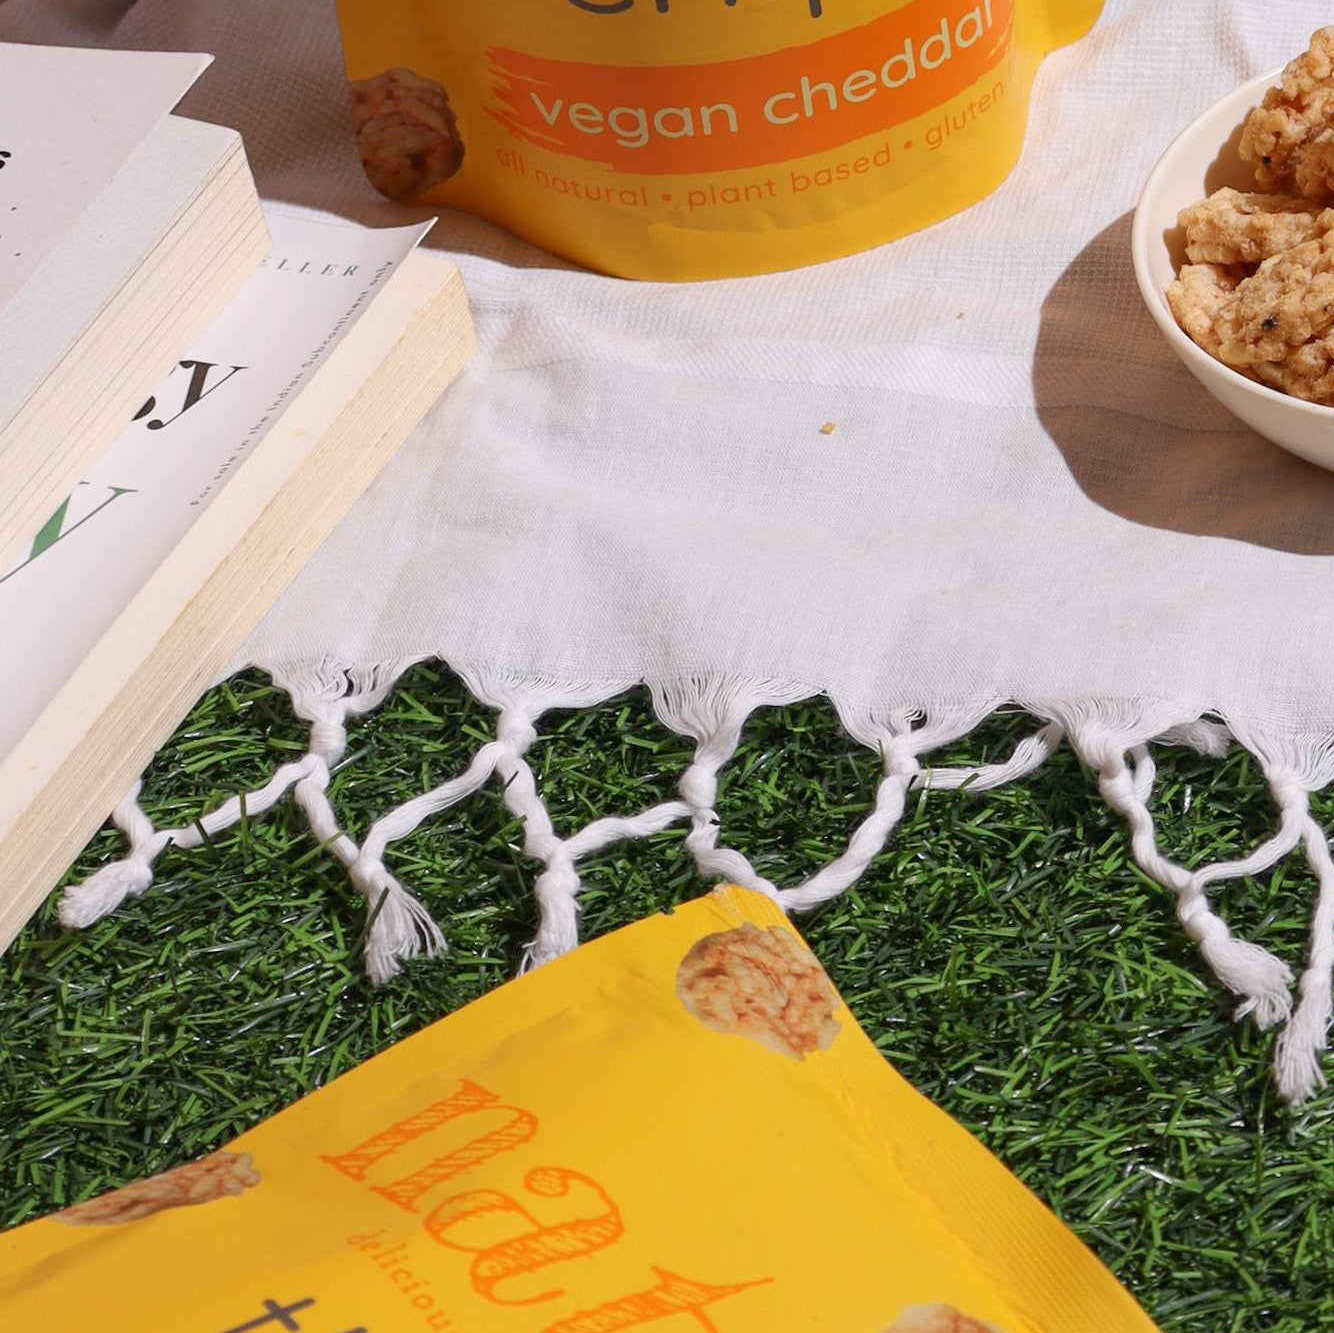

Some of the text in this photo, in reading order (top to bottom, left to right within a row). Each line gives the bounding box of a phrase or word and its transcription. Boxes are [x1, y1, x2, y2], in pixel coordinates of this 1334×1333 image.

[495, 80, 1006, 213] all natural plant based gluten
[529, 92, 740, 148] vegan
